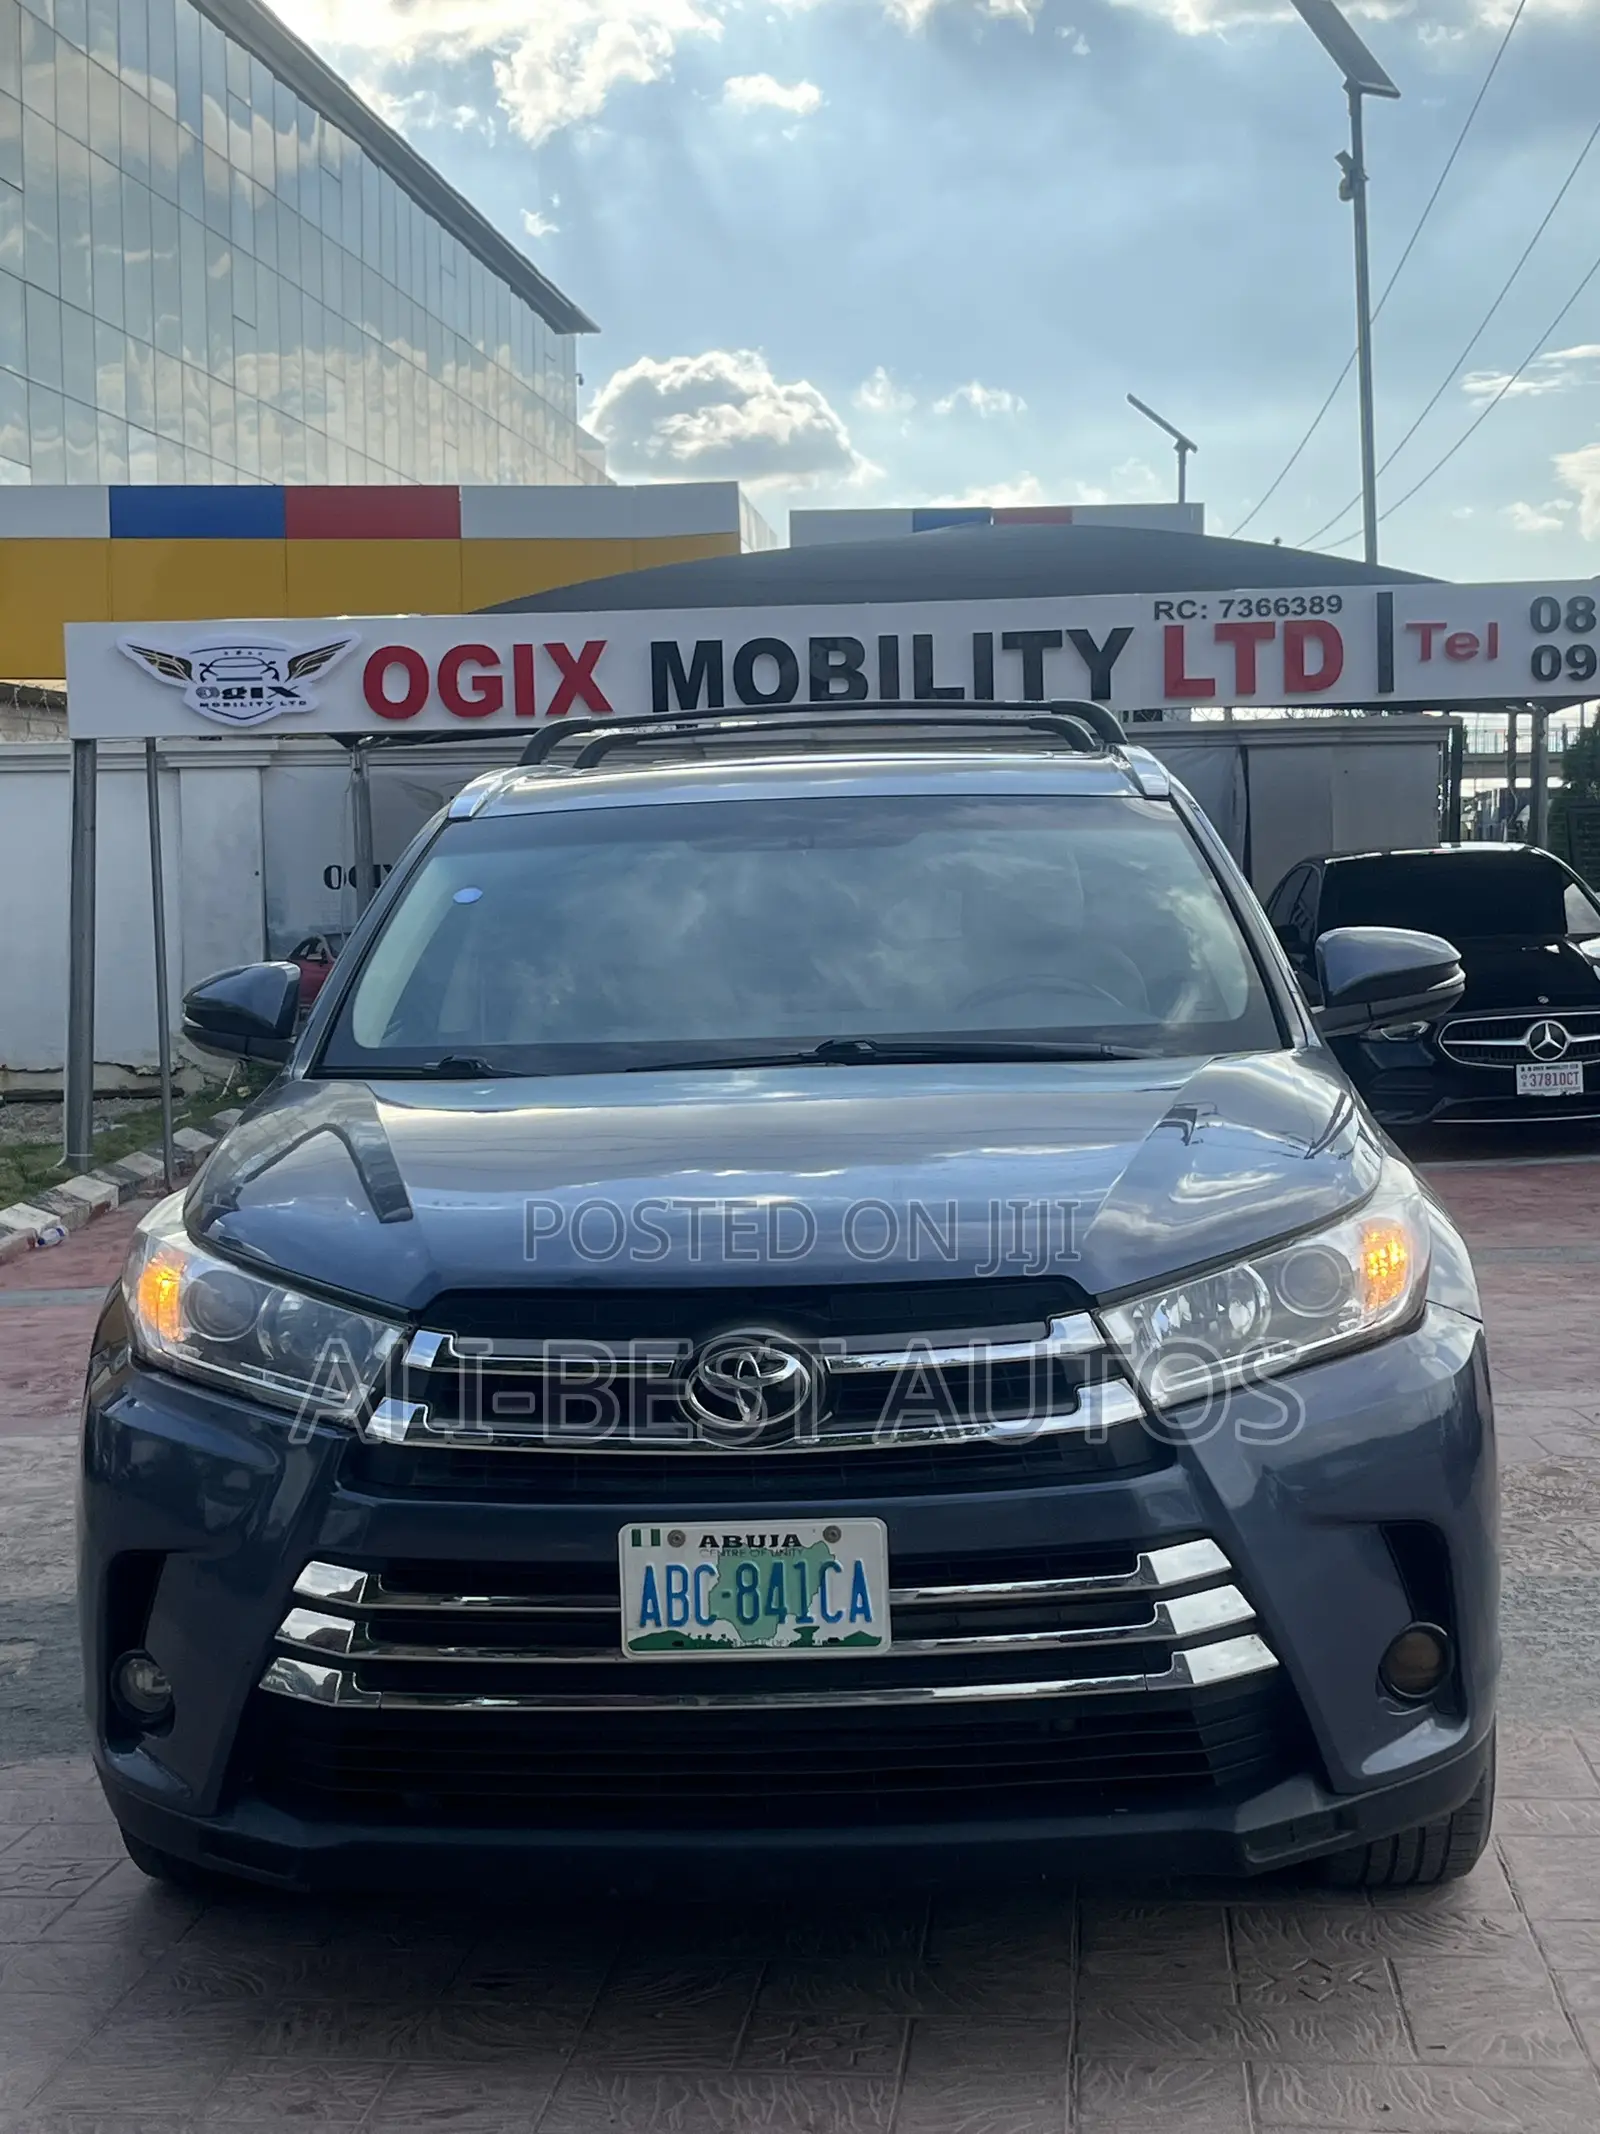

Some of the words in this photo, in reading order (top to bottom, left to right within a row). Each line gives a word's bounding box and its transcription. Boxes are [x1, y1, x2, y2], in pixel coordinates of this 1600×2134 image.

[1153, 601, 1207, 621] RC:
[1218, 594, 1343, 618] 7366389
[1529, 596, 1597, 633] 08
[1406, 622, 1498, 662] Tel
[363, 640, 613, 720] OGIX
[650, 627, 1134, 713] MOBILITY
[1164, 620, 1344, 698] LTD
[1530, 644, 1597, 682] 09
[699, 1534, 802, 1548] ABUJA
[699, 1548, 746, 1558] CENTRE
[749, 1548, 768, 1558] OF
[640, 1559, 873, 1628] ABC-841CA
